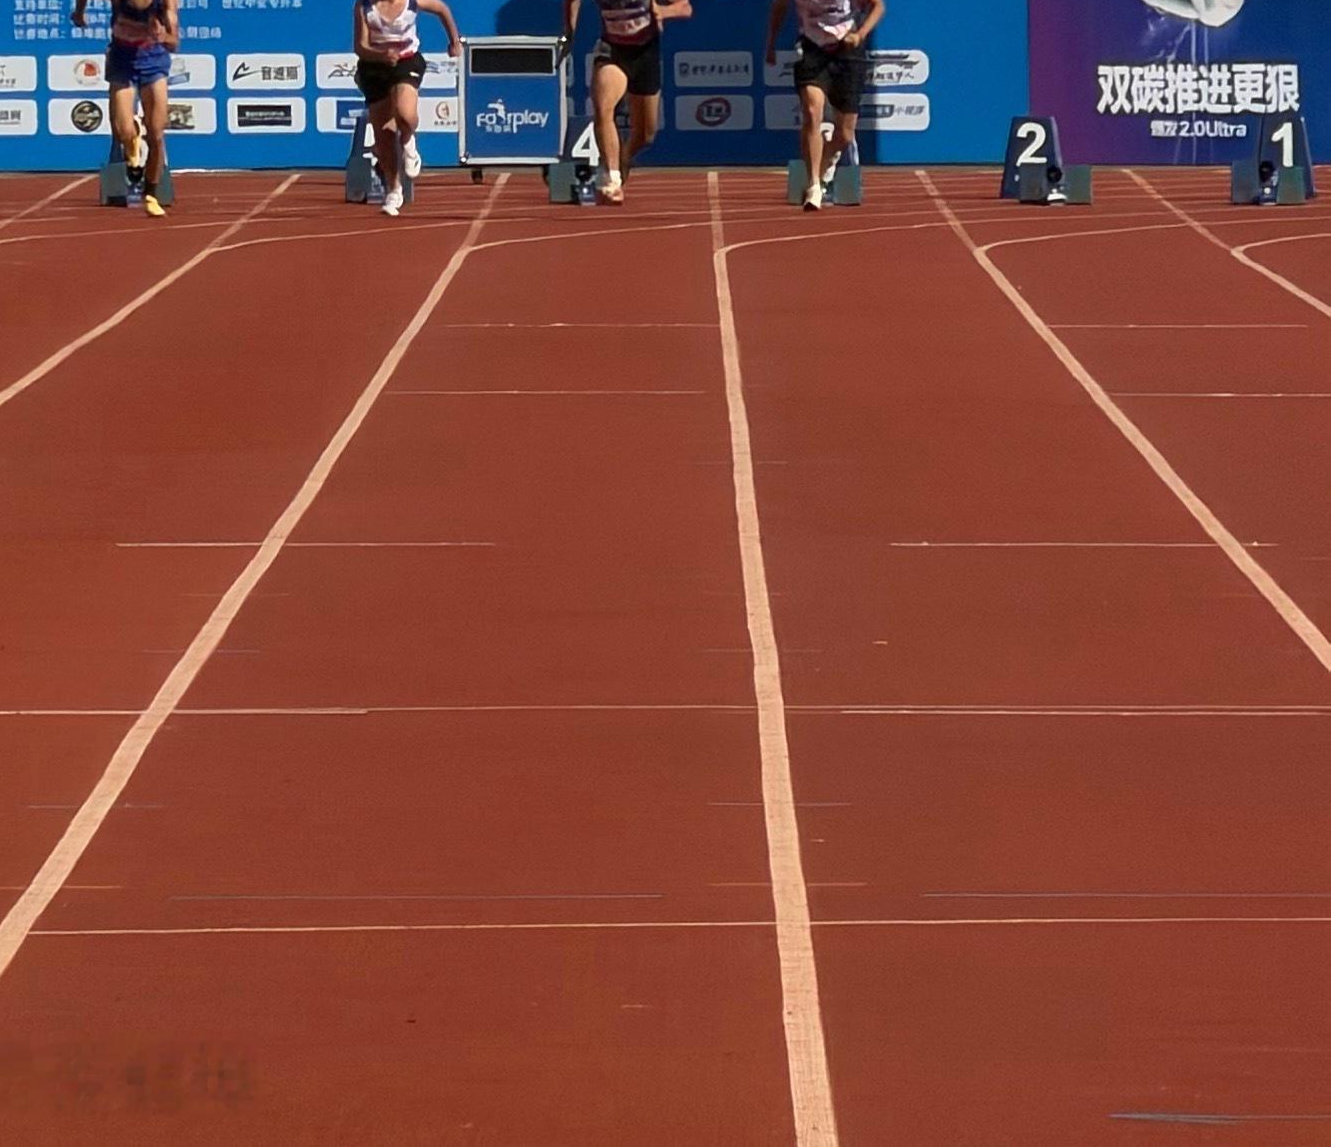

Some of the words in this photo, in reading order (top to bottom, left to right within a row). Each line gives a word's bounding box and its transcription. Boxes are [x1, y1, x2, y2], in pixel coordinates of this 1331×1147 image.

[1097, 63, 1300, 114] 双碳推进更狠
[571, 120, 601, 167] 4
[1015, 121, 1048, 167] 2
[1271, 122, 1294, 168] 1
